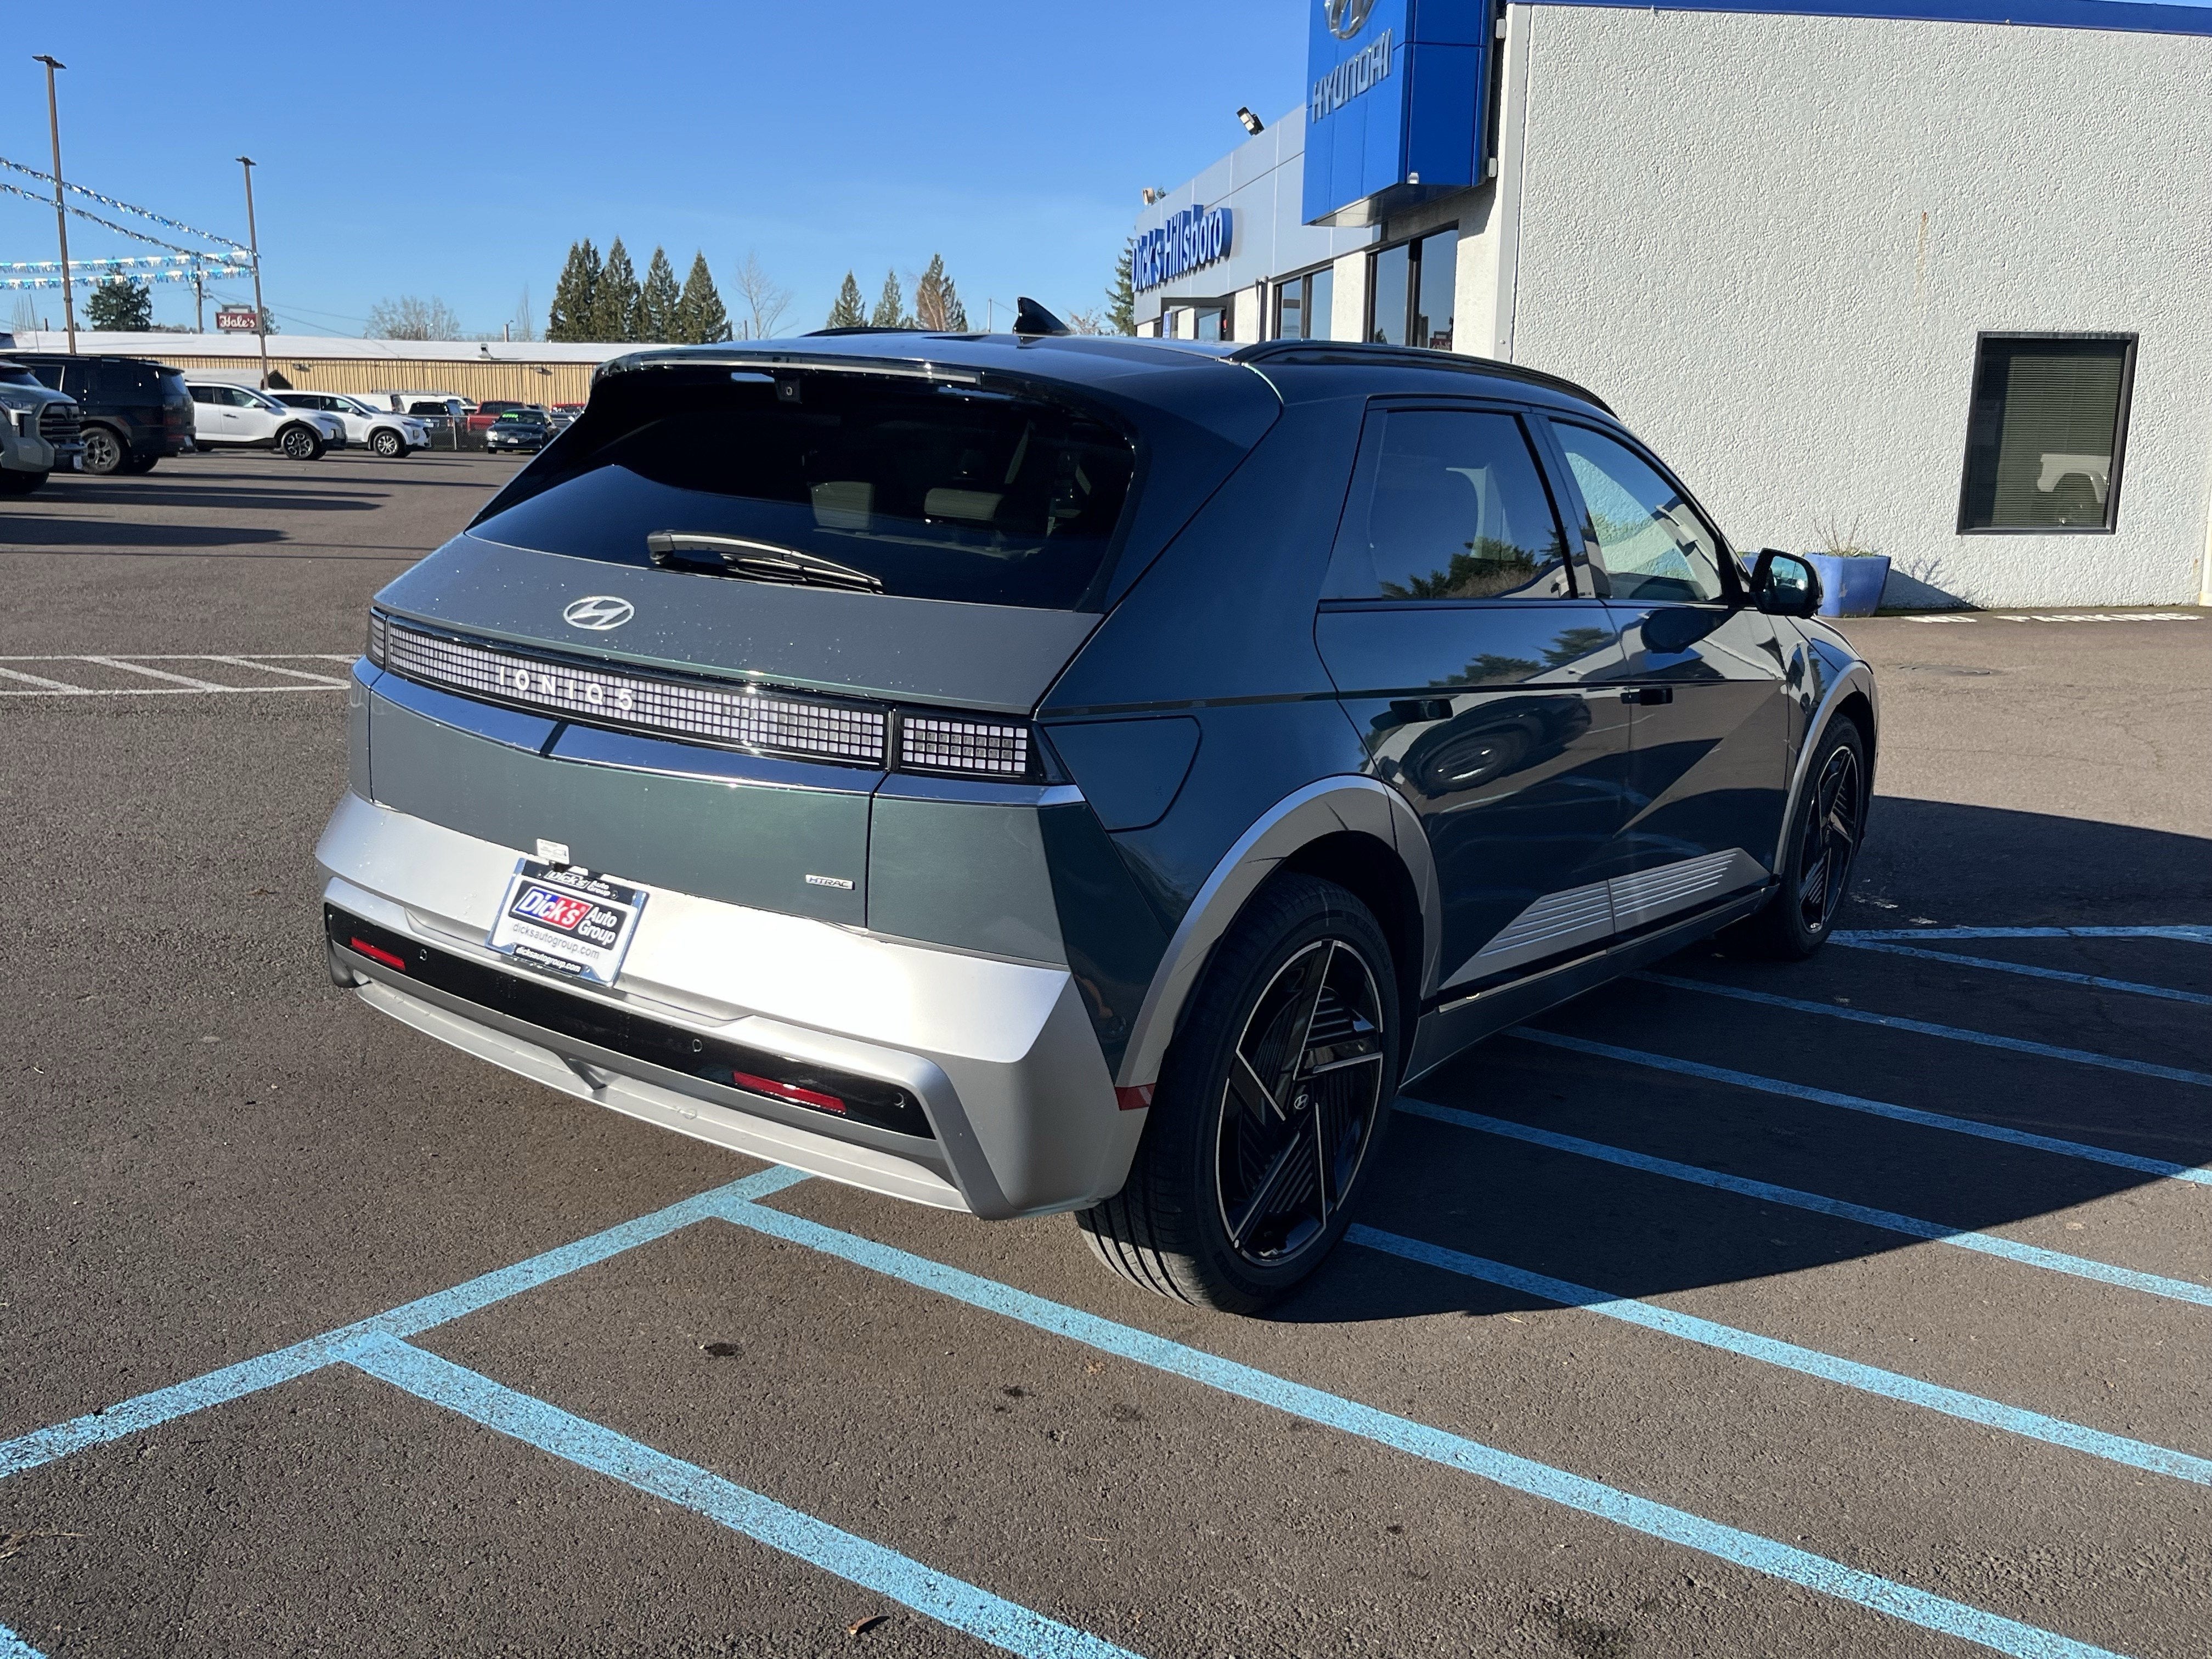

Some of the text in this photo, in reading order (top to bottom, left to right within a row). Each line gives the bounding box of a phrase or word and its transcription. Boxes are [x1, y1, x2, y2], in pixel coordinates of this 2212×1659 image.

[1312, 28, 1392, 123] HYUNDAI
[1132, 205, 1229, 292] Dick's Hillsboro
[219, 314, 255, 328] Hale's
[500, 665, 633, 710] IONIQ 5
[809, 877, 849, 888] HTRAC
[519, 890, 580, 926] Dick's
[585, 906, 618, 928] Auto
[513, 923, 600, 960] dicksautogroup.com
[578, 919, 616, 945] Group
[516, 946, 582, 973] dicksautogroup.com
